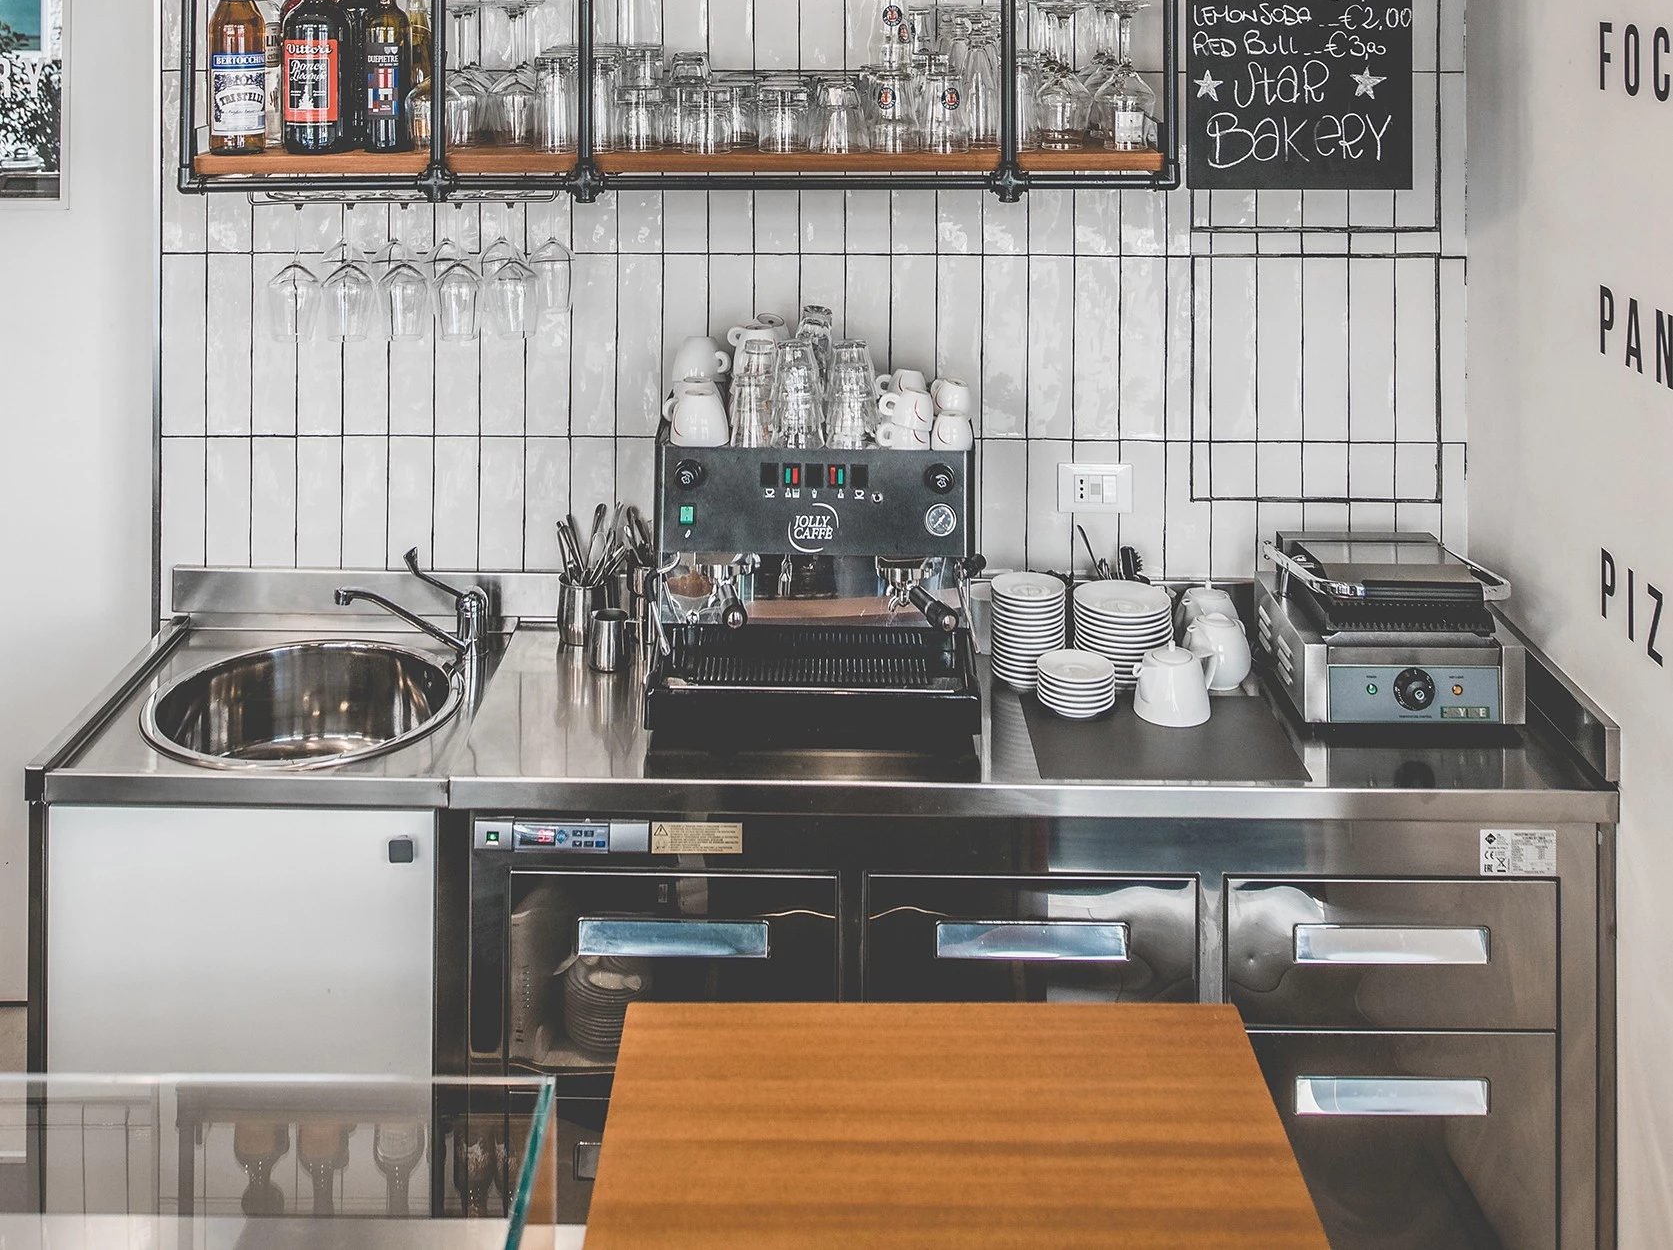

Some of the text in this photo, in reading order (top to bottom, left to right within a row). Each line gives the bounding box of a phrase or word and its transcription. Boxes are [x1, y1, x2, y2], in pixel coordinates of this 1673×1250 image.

[286, 43, 333, 54] Vittori
[1193, 31, 1237, 57] RED
[290, 59, 328, 74] Ponce
[1599, 21, 1671, 102] FOC
[1599, 283, 1673, 391] PAN
[793, 515, 831, 529] JOLLY
[1600, 546, 1664, 668] PIZ
